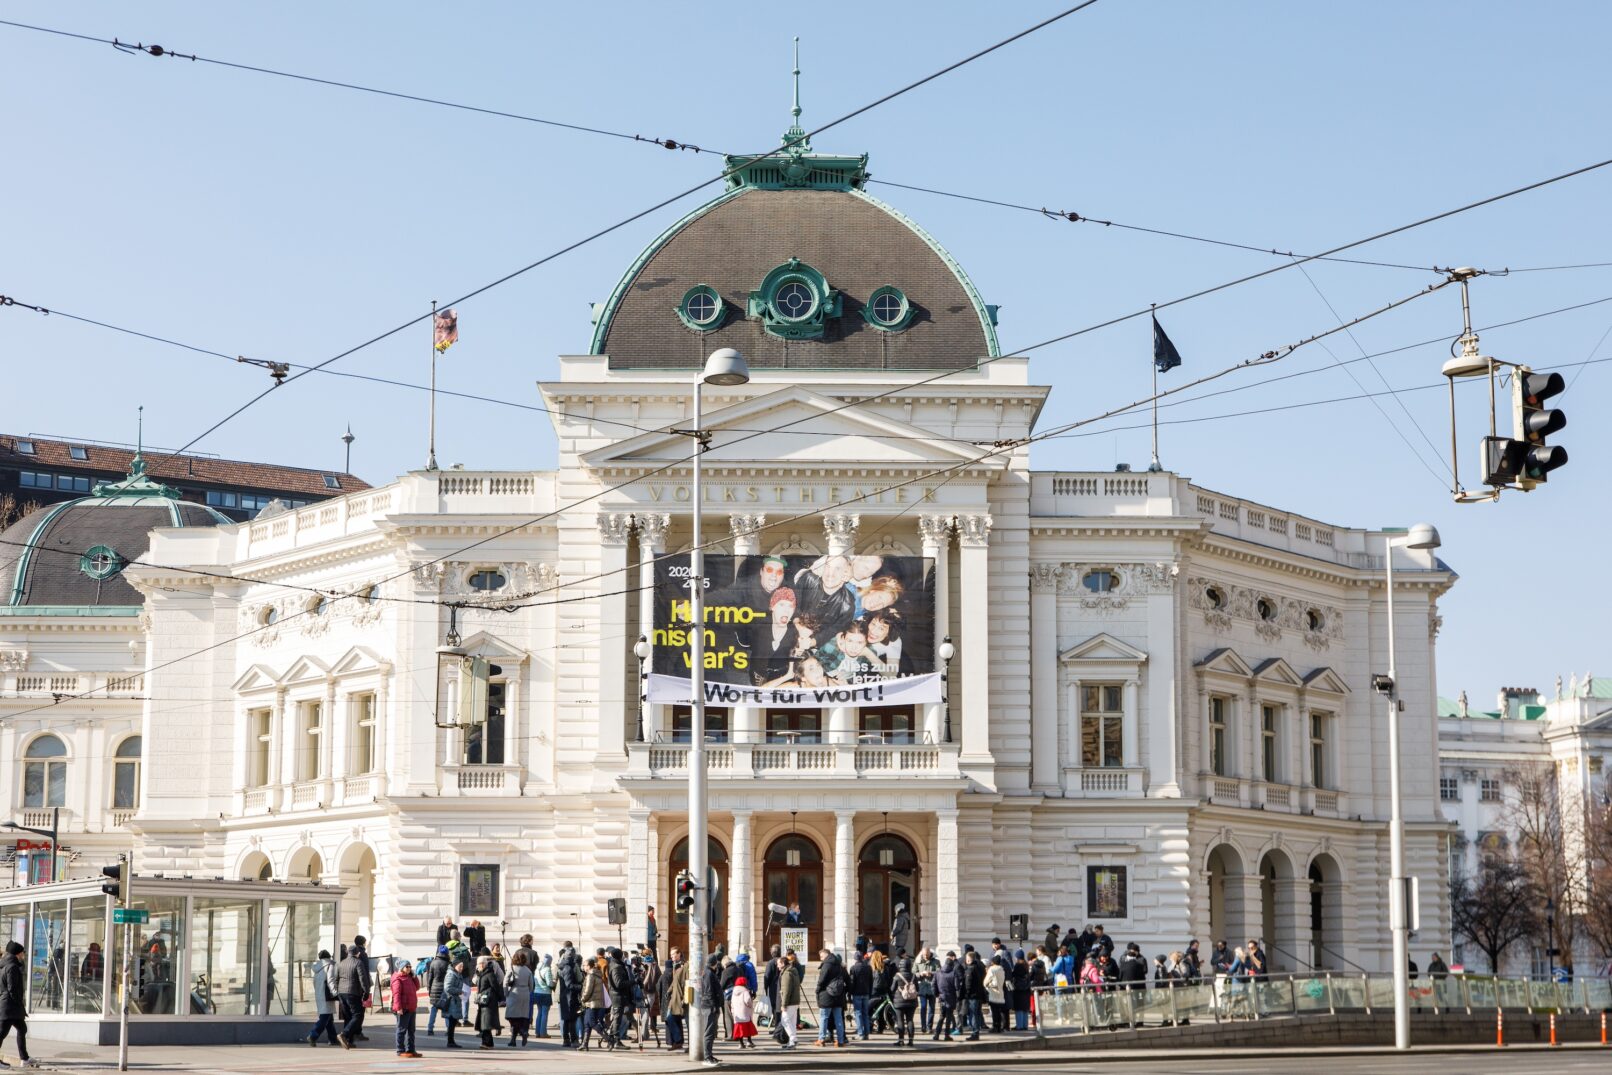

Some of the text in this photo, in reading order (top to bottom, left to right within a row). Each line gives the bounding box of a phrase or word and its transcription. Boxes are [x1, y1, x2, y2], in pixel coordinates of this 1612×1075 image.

[649, 485, 937, 503] VOLKSTHEATER
[682, 578, 710, 588] 25
[671, 599, 767, 623] Hrmo-
[652, 624, 716, 647] nish
[704, 683, 762, 703] Wort
[770, 689, 806, 703] für
